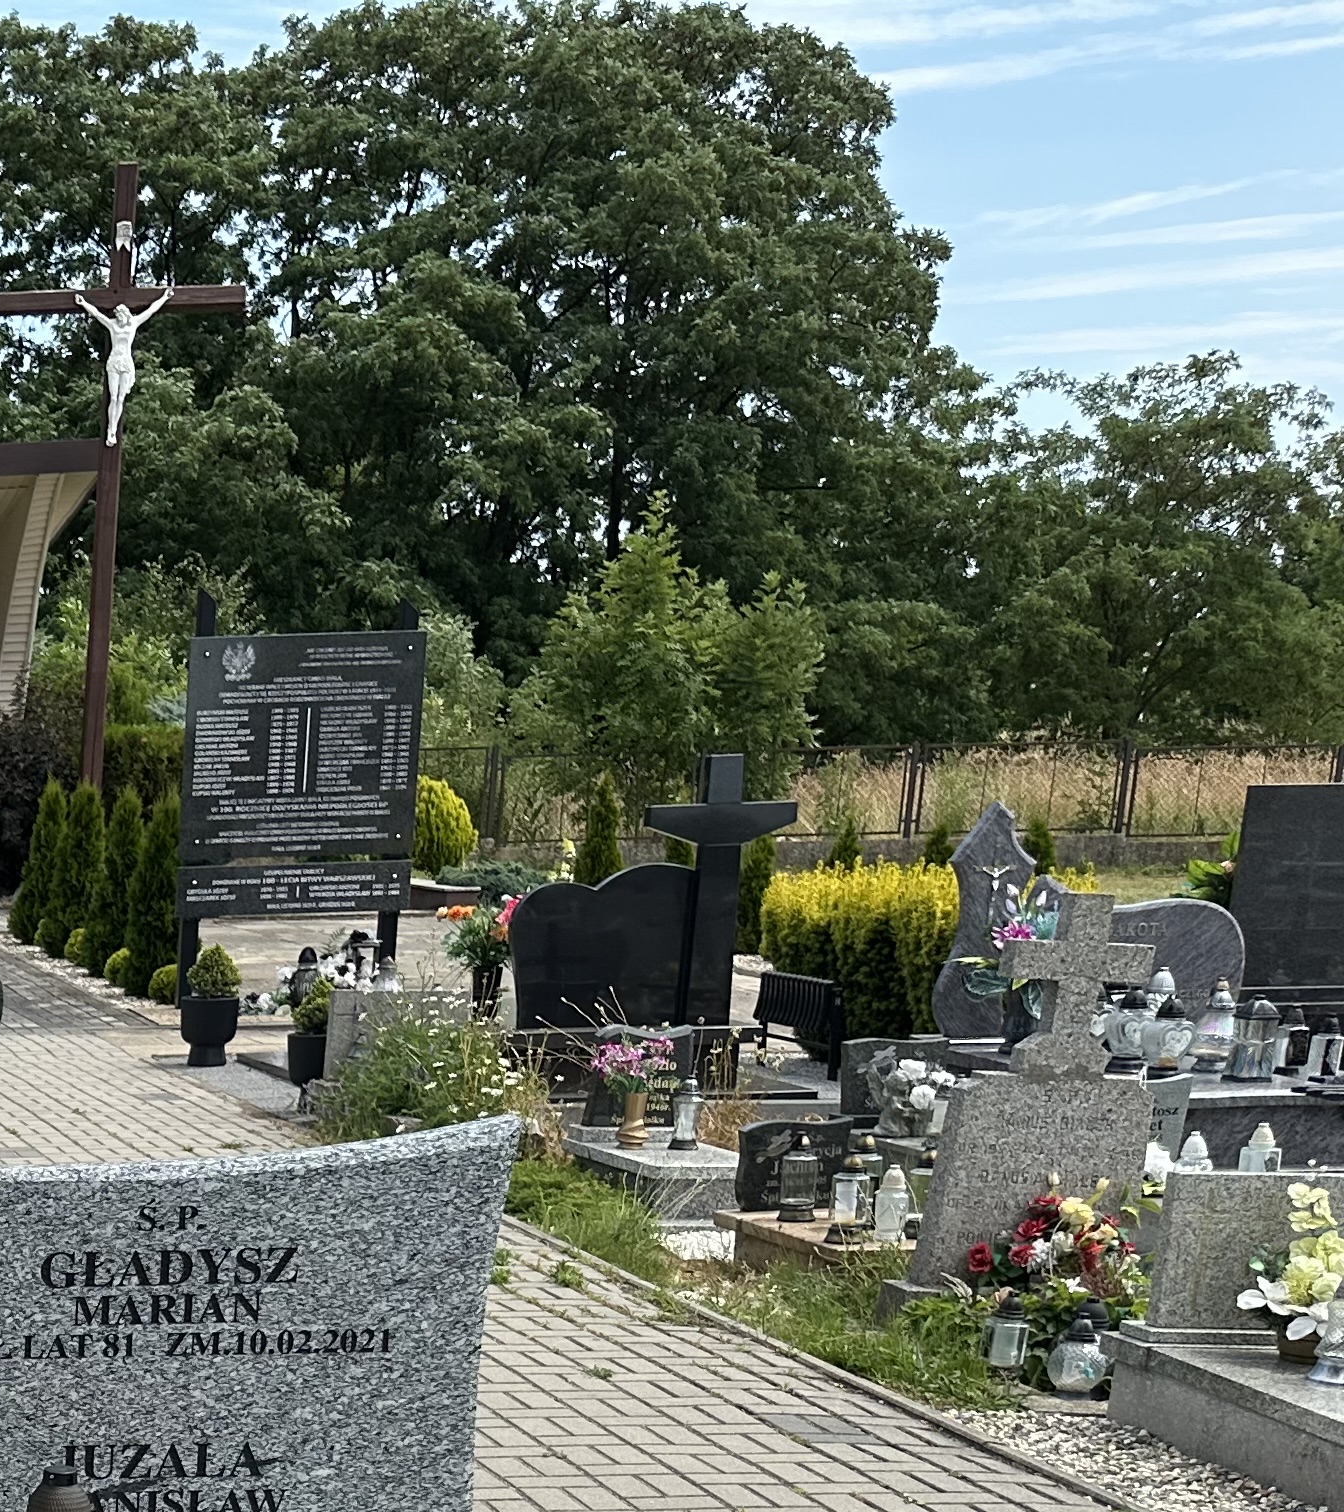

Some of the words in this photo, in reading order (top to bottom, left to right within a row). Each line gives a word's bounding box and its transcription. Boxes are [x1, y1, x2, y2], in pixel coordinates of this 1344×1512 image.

[40, 1245, 300, 1289] GŁADYSZ
[73, 1291, 262, 1327] MARIAN
[22, 1333, 96, 1361] LAT
[102, 1331, 135, 1360] 81
